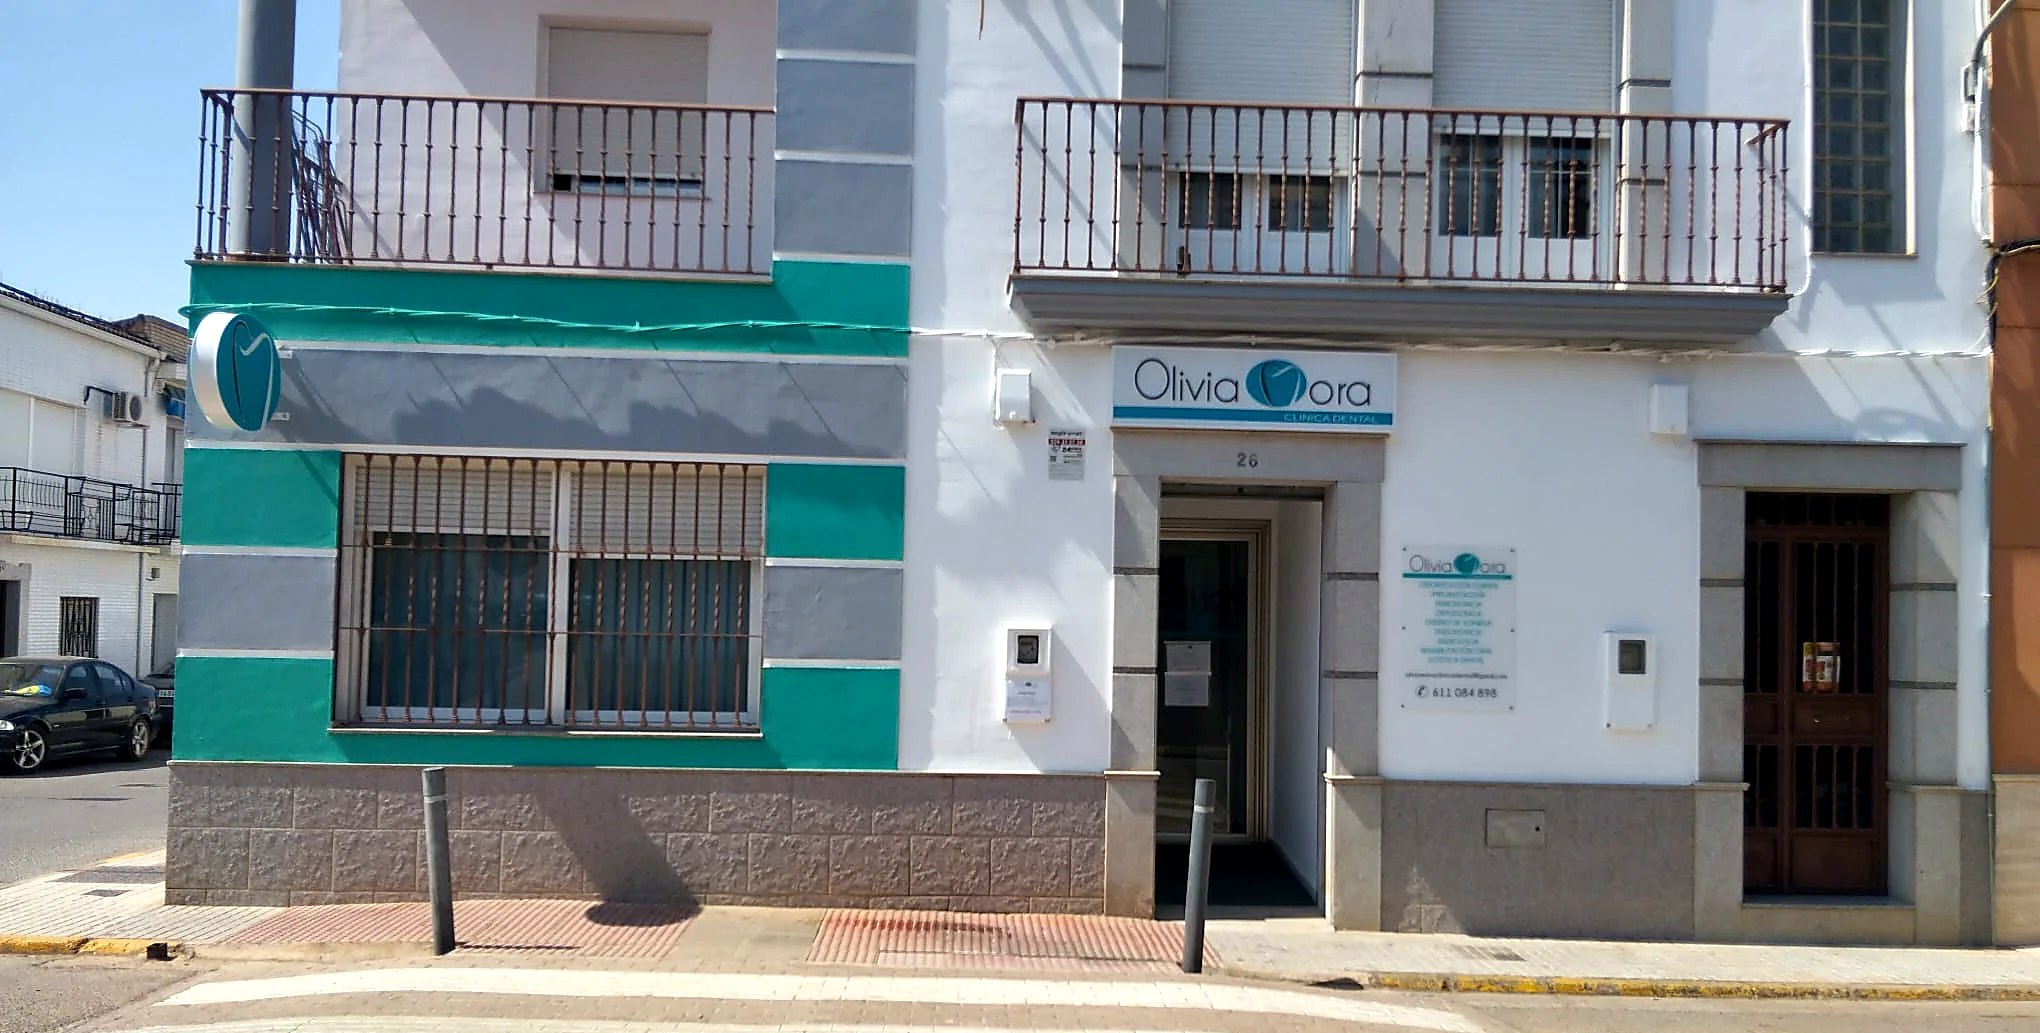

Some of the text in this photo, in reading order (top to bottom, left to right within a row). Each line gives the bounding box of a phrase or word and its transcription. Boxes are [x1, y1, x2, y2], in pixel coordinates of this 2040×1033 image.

[1134, 358, 1239, 403] Olivia
[1332, 415, 1377, 425] DENTAL
[1236, 452, 1258, 468] 26
[1409, 554, 1452, 573] Olivia
[1432, 687, 1451, 698] 611
